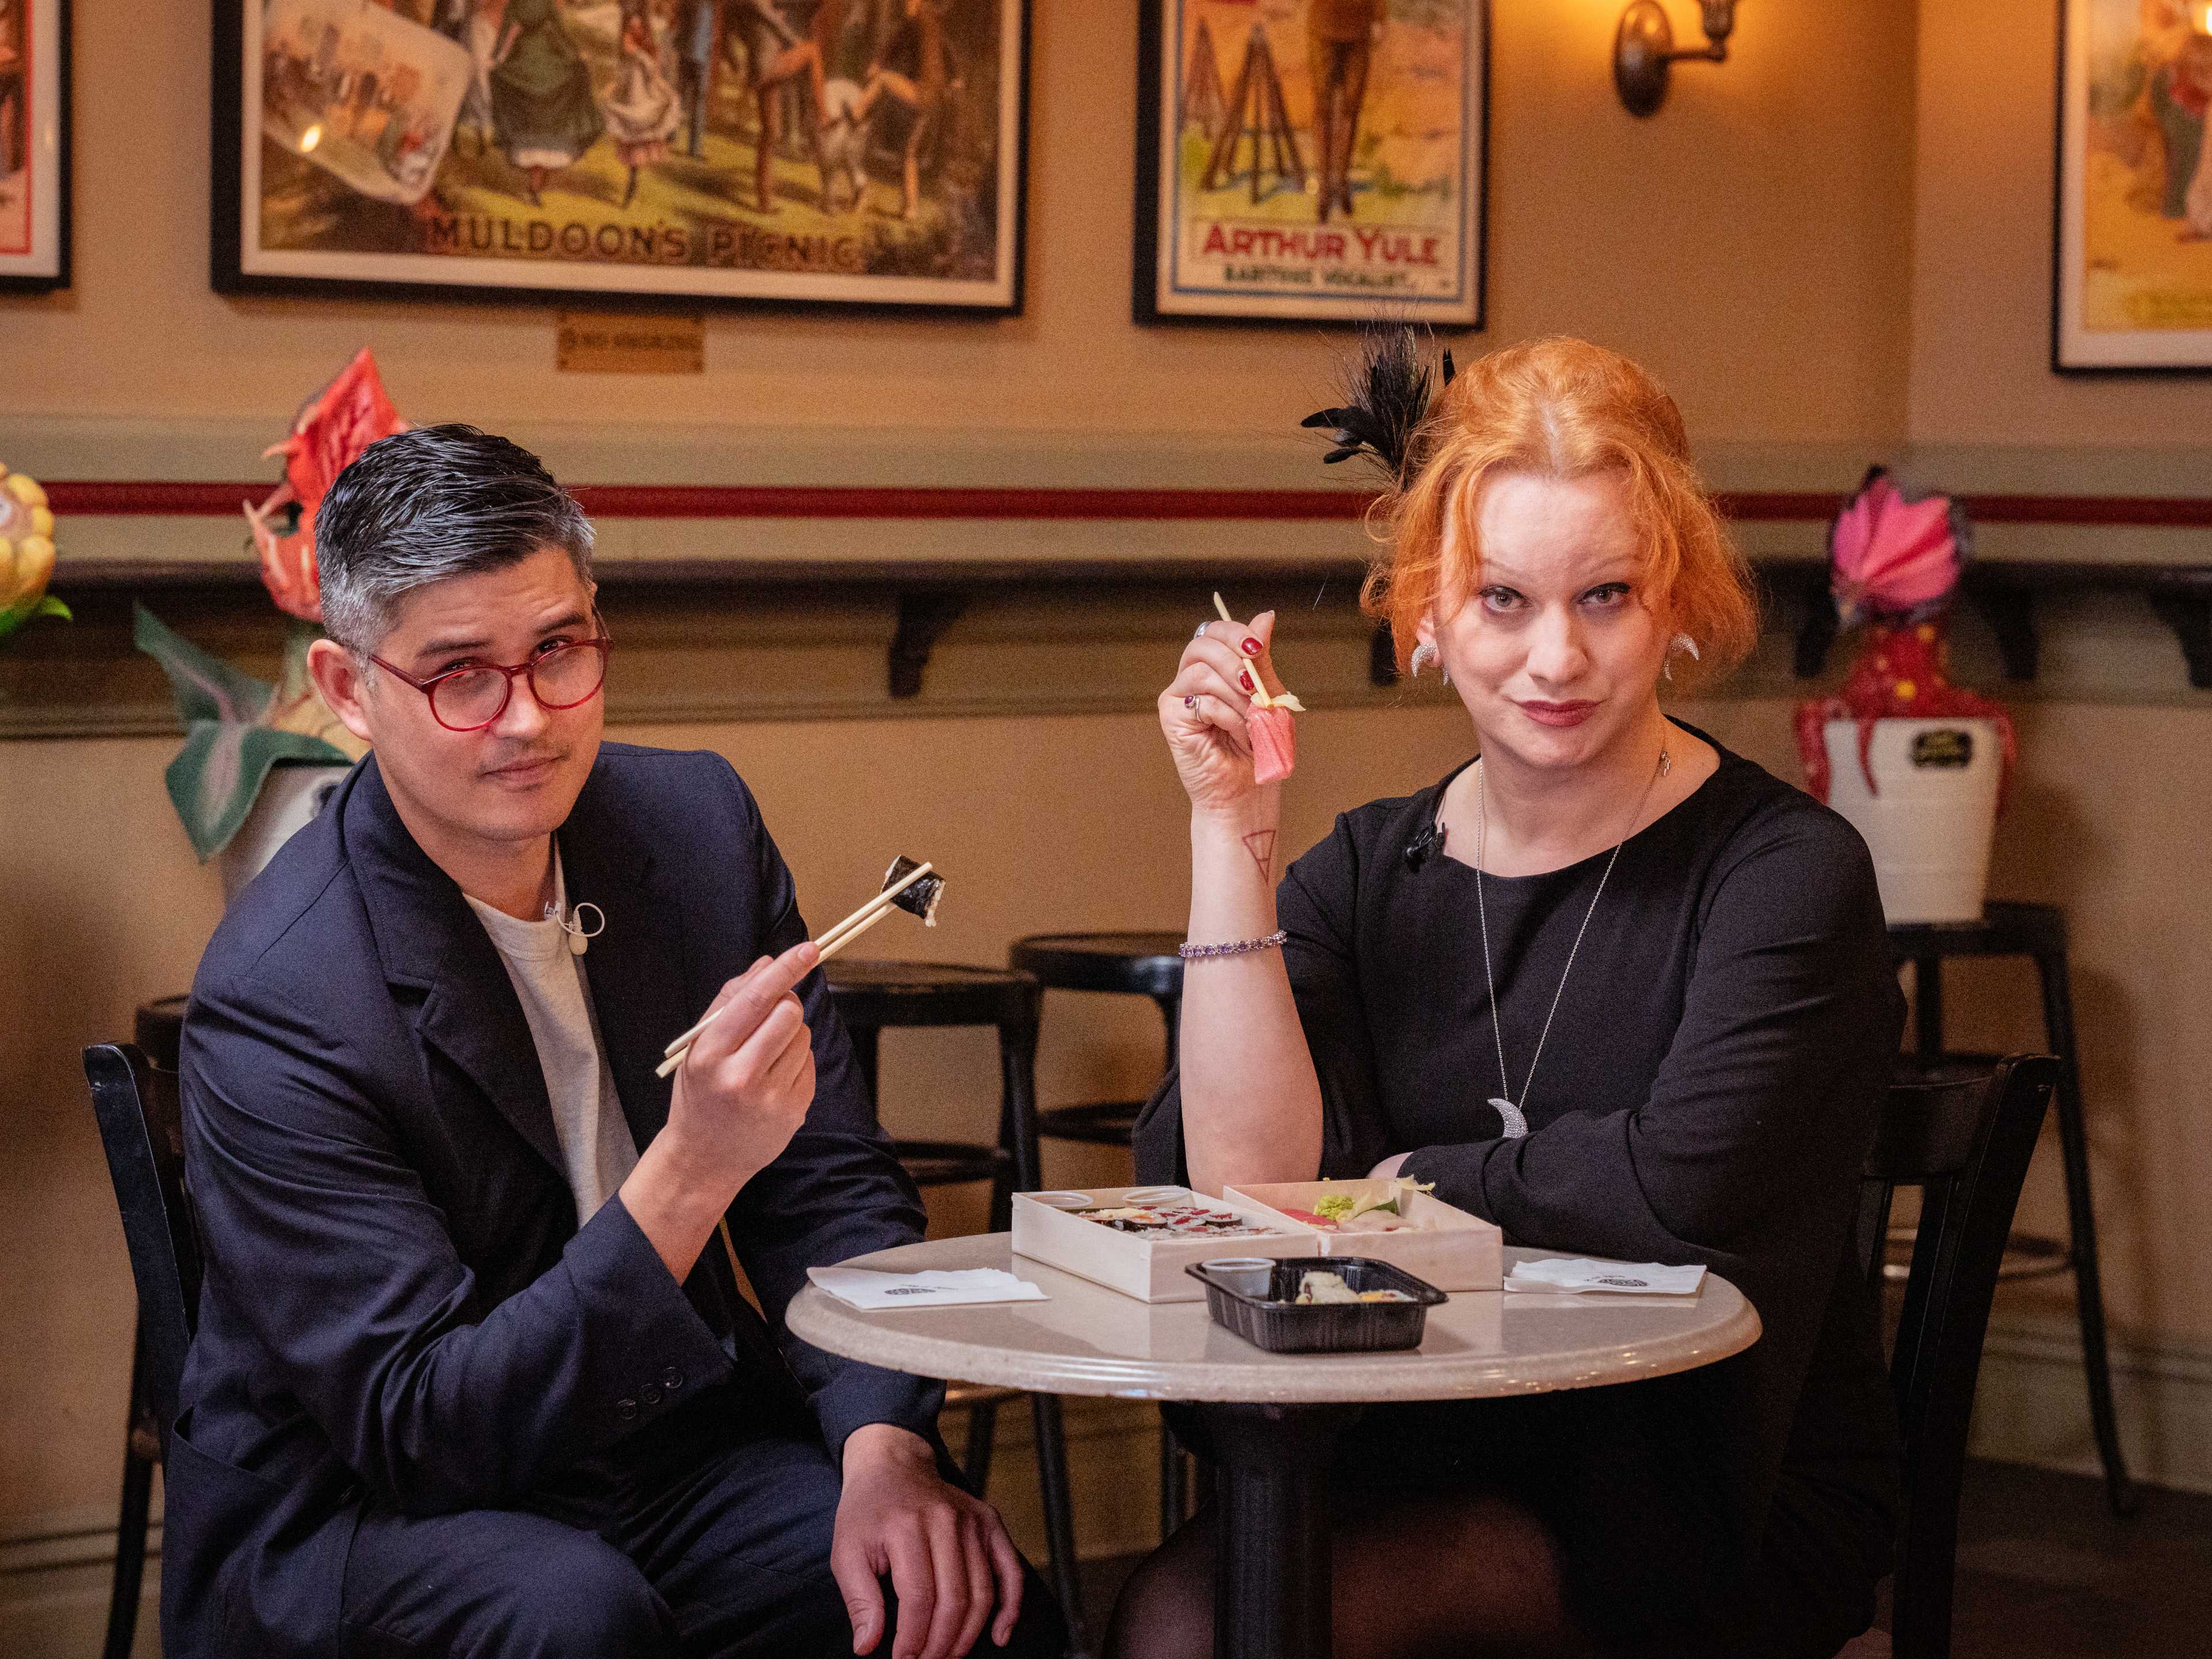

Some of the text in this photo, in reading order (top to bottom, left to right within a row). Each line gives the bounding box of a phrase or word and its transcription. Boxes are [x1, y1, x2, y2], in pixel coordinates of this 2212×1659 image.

[427, 215, 688, 259] MULDOON'S
[1203, 223, 1440, 266] ARTHUR YULE
